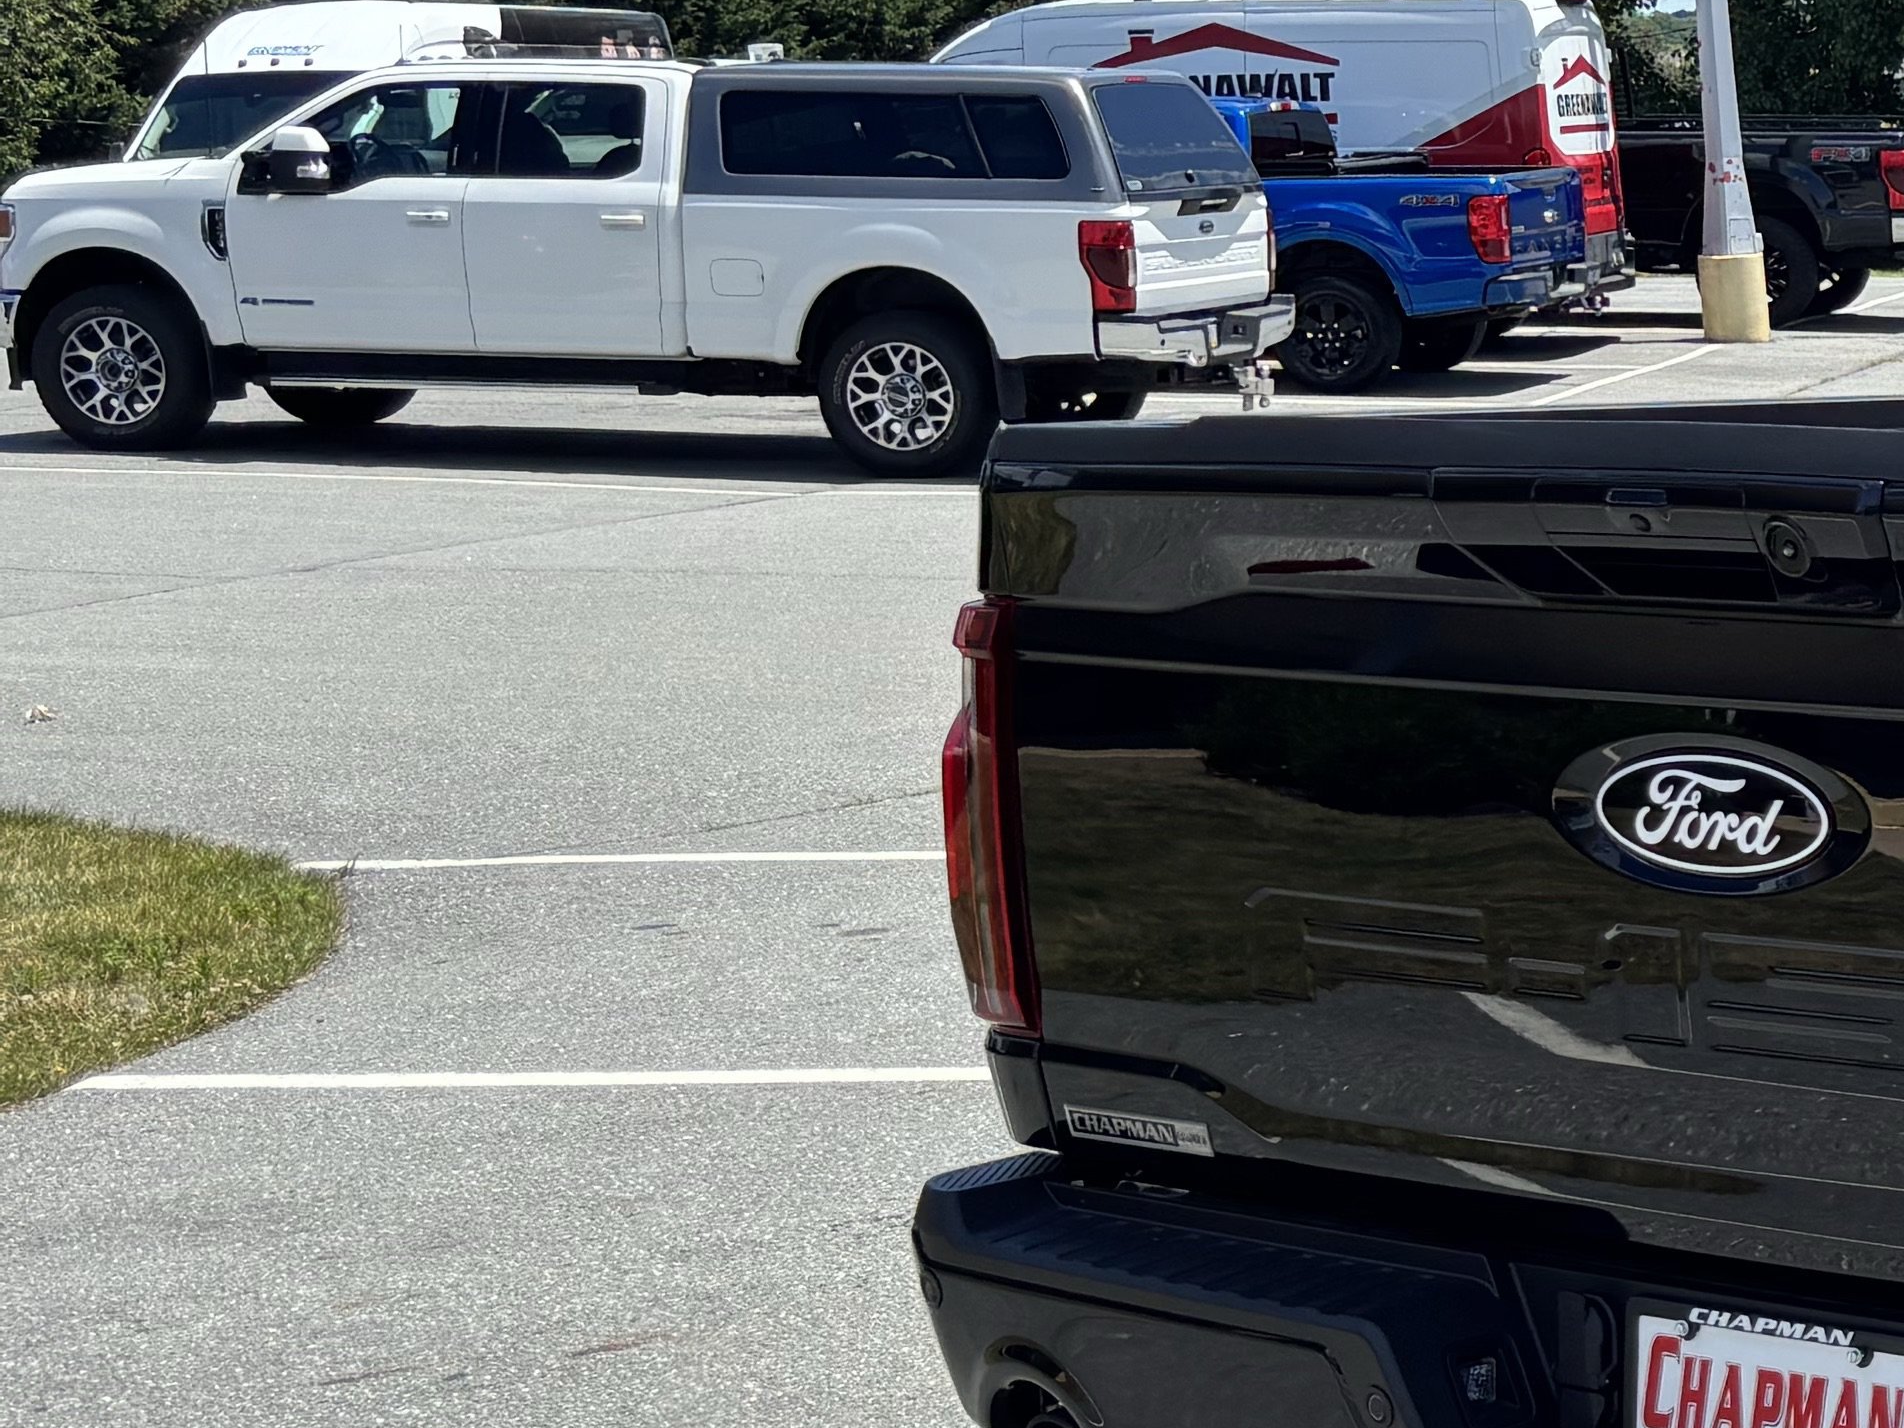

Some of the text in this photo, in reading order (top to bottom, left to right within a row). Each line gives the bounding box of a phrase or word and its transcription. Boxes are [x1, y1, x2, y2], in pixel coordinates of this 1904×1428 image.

[1635, 769, 1785, 856] Ford
[1072, 1112, 1176, 1145] CHAPMAN
[1688, 1307, 1855, 1346] CHAPMAN
